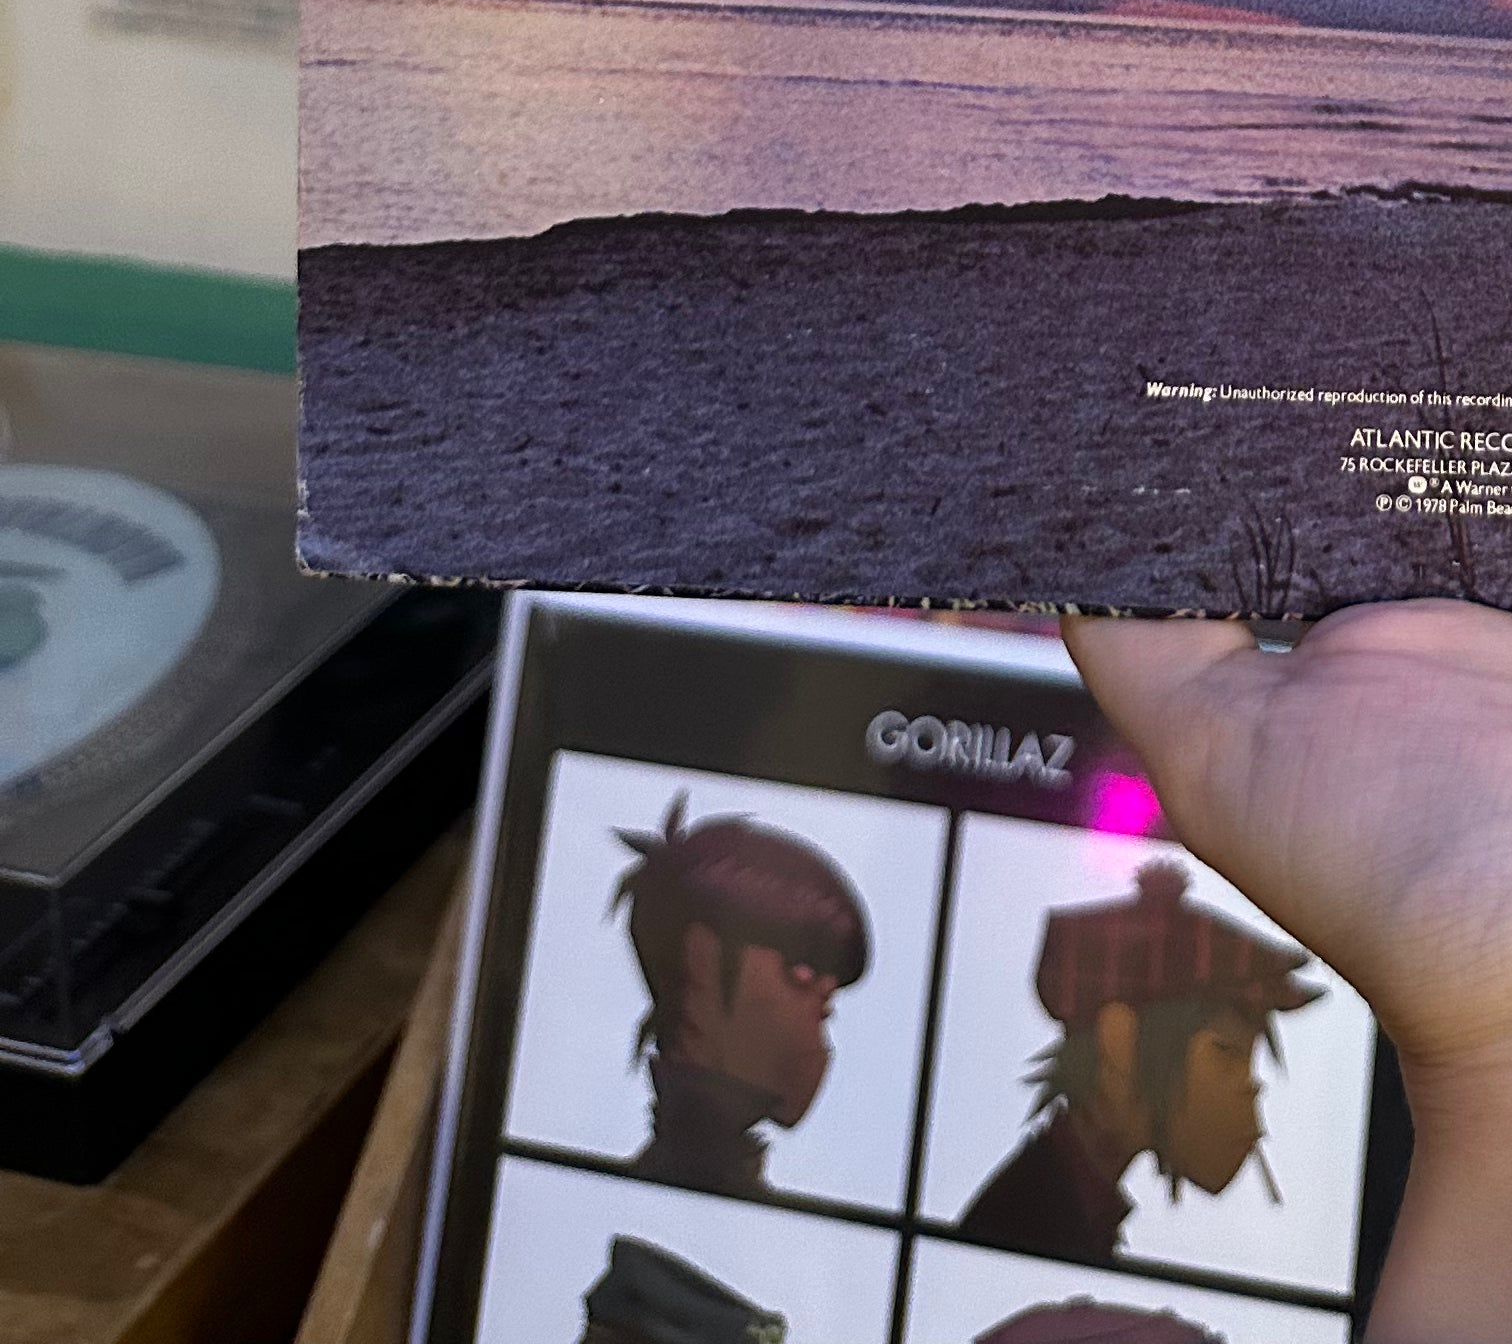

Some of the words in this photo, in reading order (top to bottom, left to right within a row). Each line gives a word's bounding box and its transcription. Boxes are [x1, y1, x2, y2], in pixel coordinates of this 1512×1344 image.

[1350, 428, 1454, 449] ATLANTIC
[1340, 457, 1356, 472] 75
[1359, 457, 1467, 475] ROCKEFELLER
[866, 710, 1077, 790] GORILLAZ
